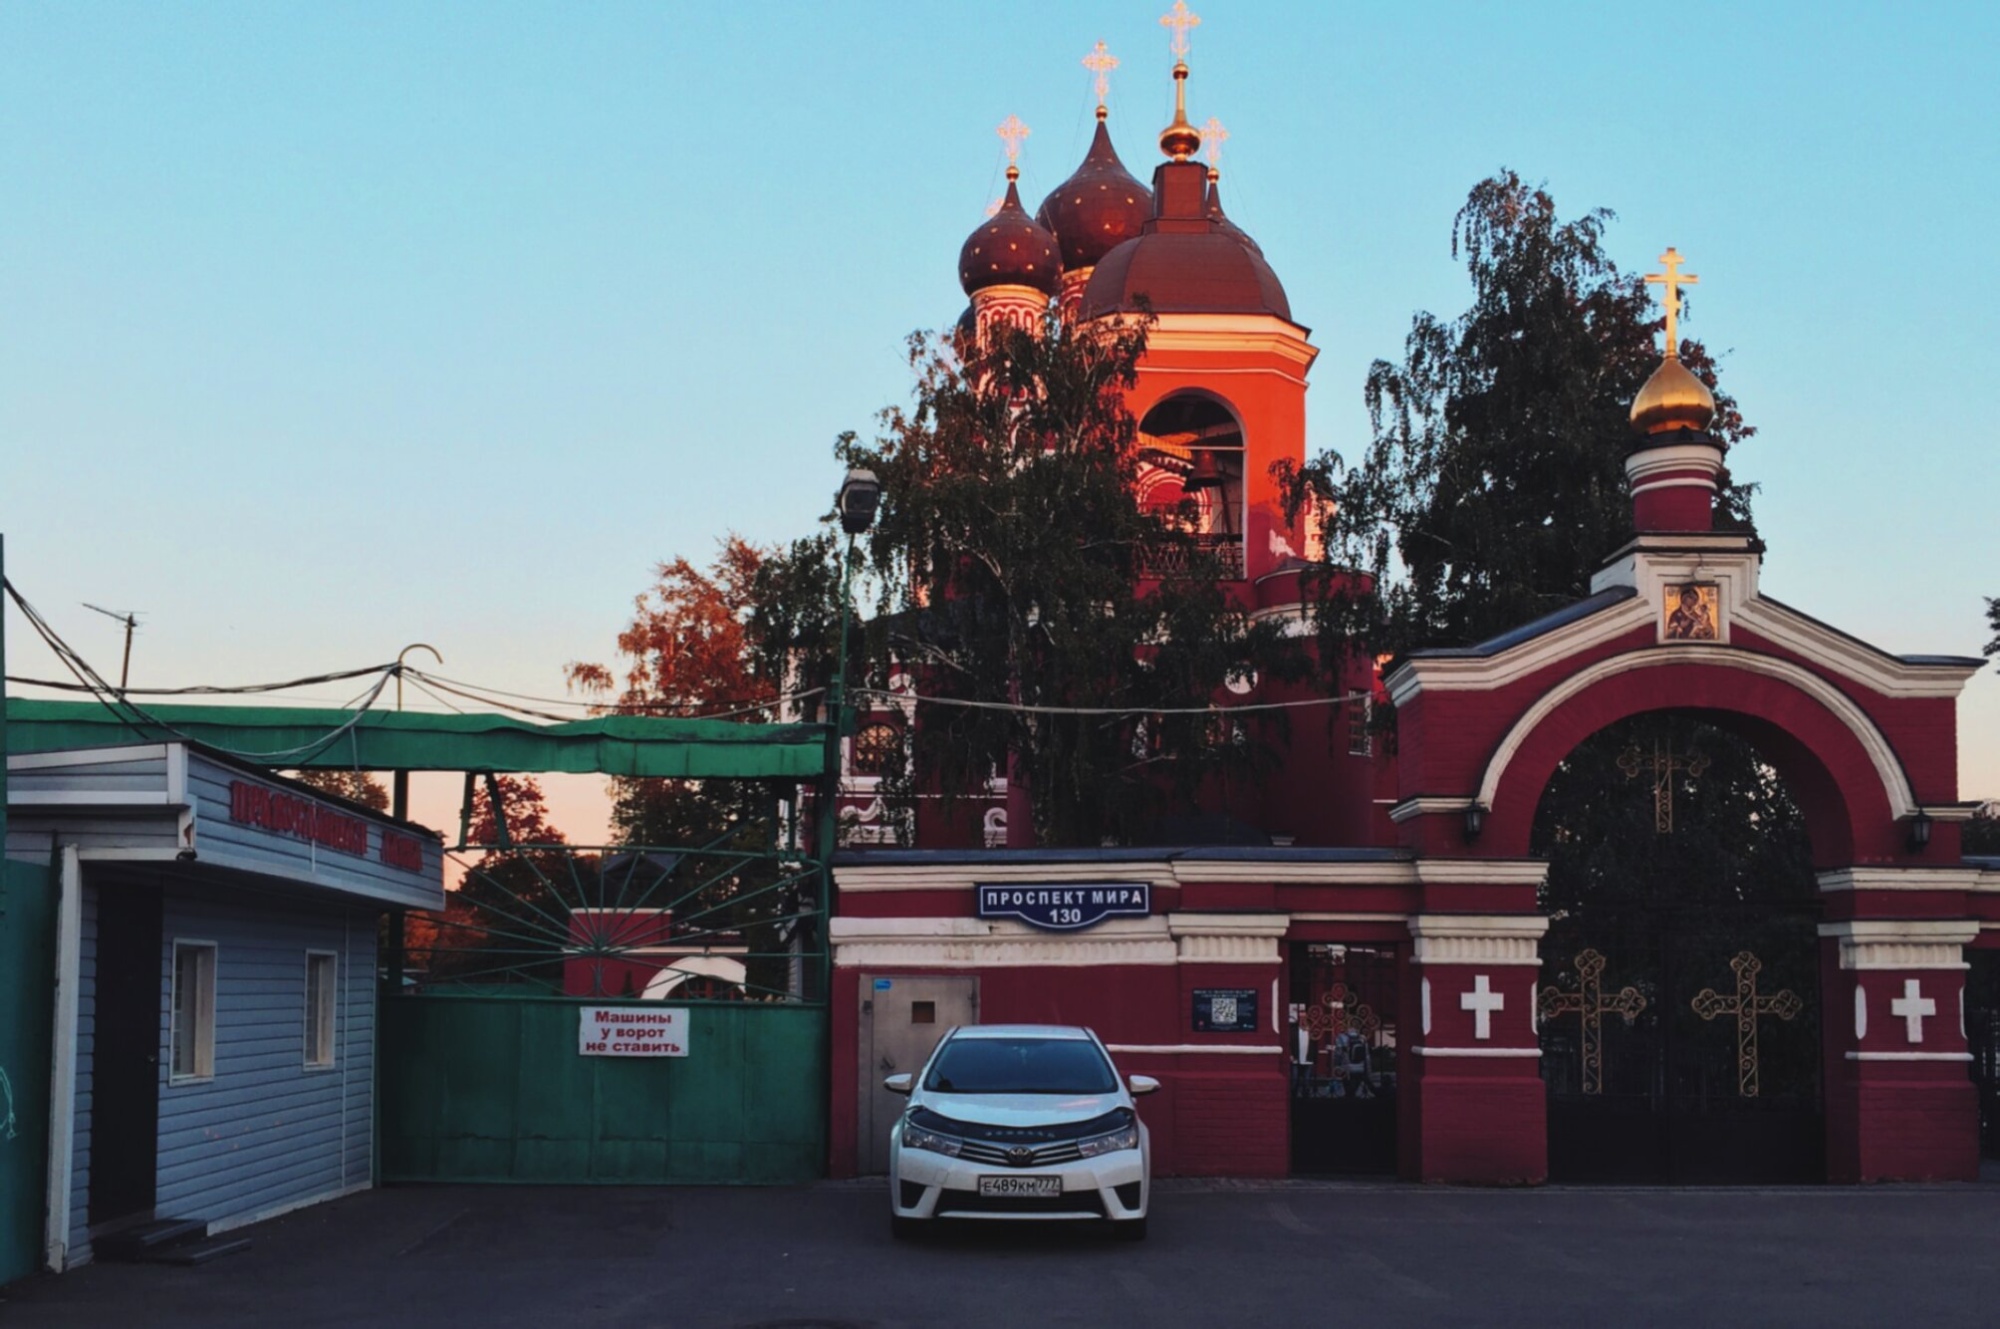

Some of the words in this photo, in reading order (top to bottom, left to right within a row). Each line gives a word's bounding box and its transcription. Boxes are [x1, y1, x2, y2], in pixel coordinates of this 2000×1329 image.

[987, 891, 1085, 906] ПРОСПЕКТ
[1092, 890, 1142, 905] МИРА
[1049, 908, 1081, 923] 130
[595, 1011, 672, 1024] Машины
[601, 1028, 611, 1040] у
[616, 1028, 666, 1040] ворот
[586, 1042, 607, 1052] не
[612, 1042, 681, 1052] ставить
